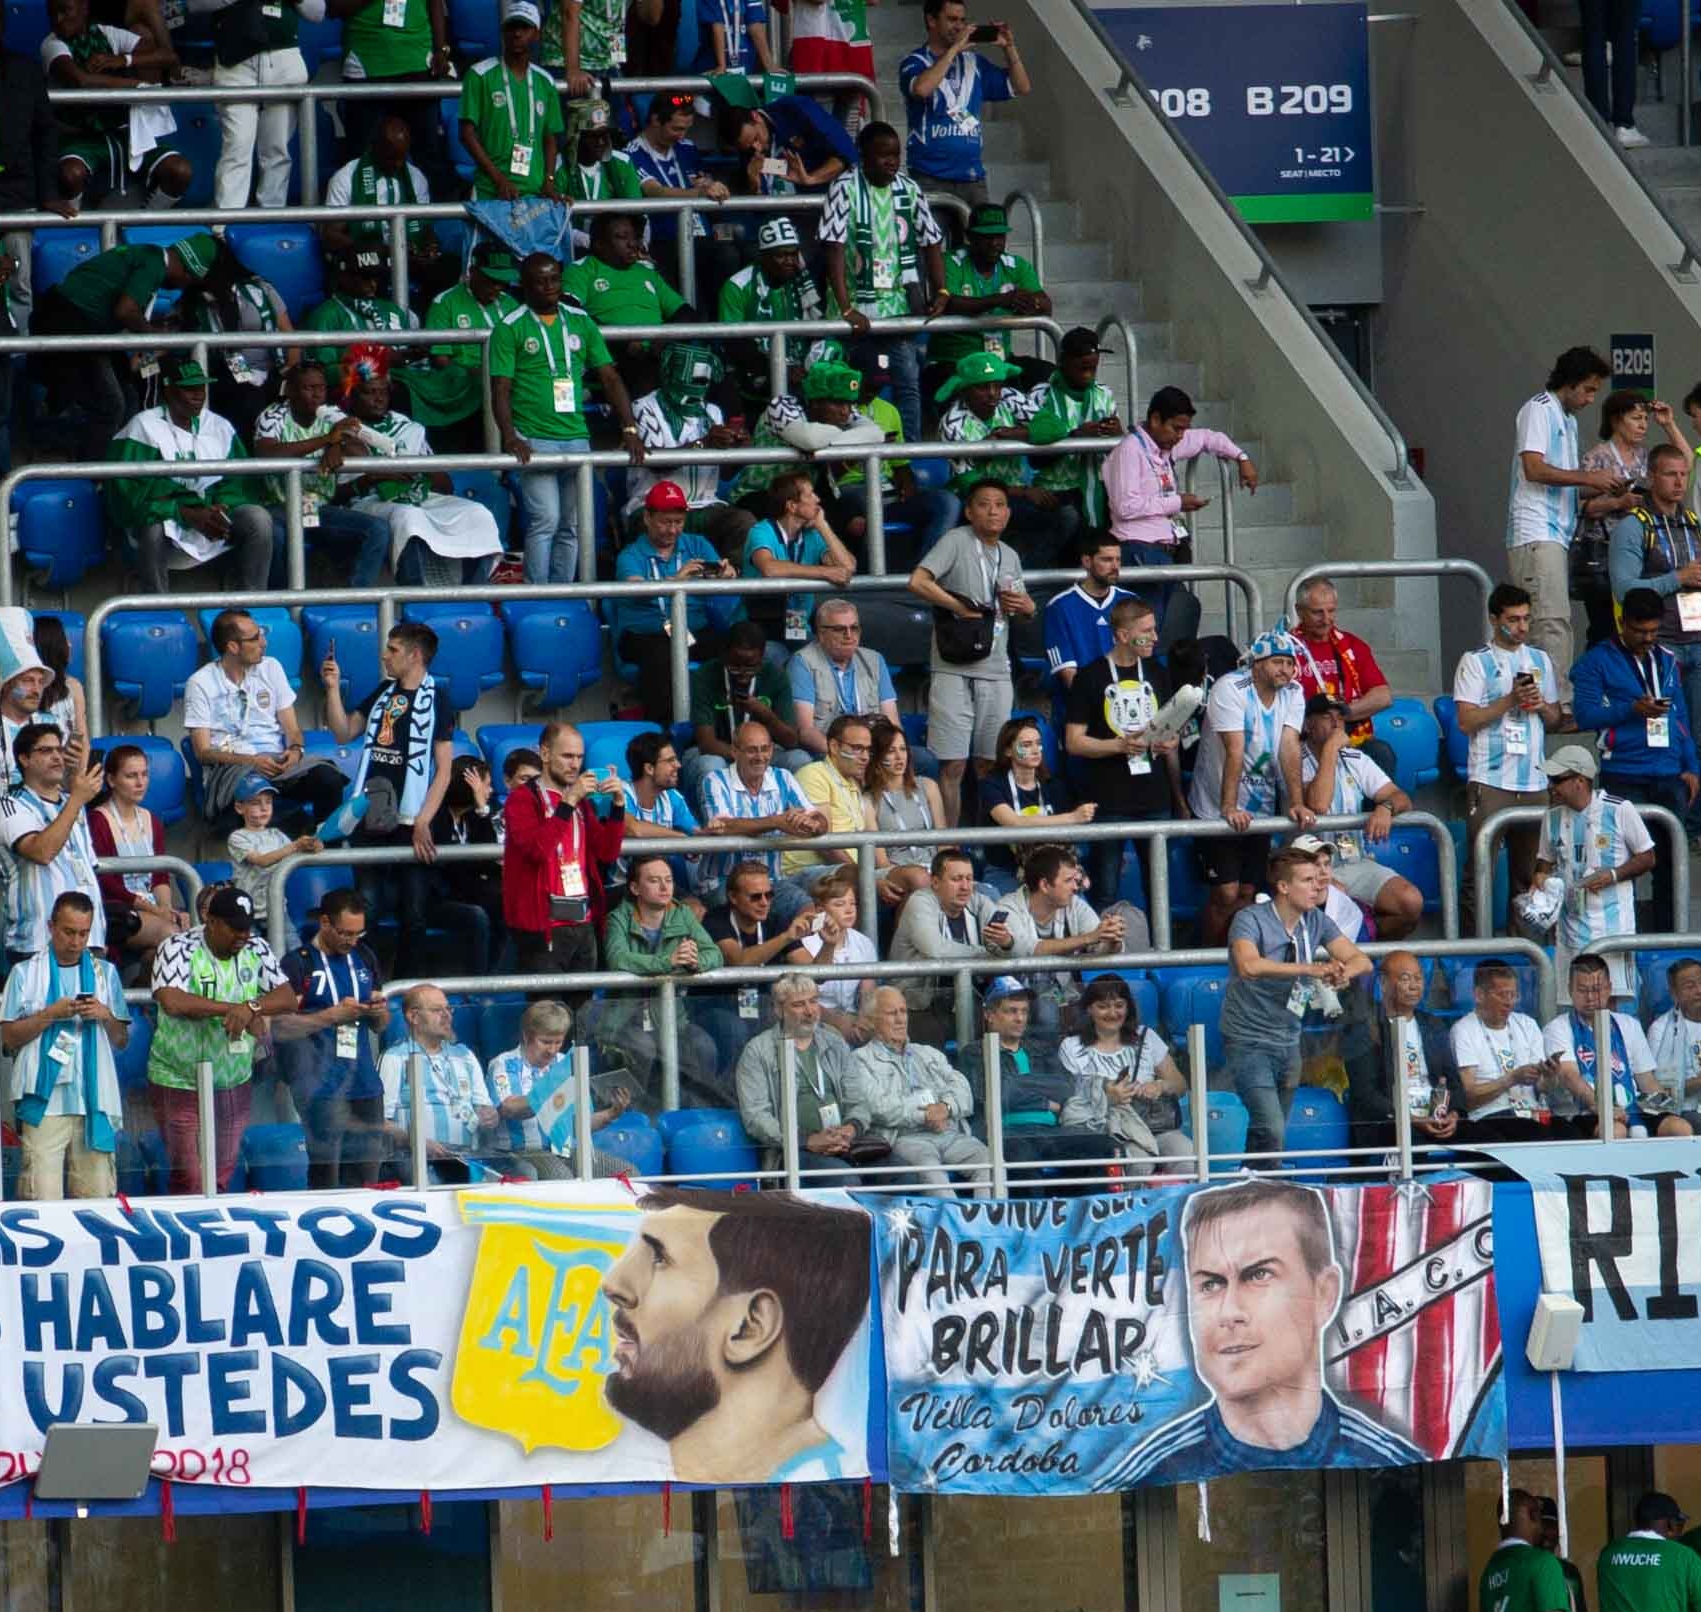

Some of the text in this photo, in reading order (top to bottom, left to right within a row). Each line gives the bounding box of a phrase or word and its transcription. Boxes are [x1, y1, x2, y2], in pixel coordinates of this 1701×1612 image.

[1612, 348, 1653, 375] B209
[312, 969, 326, 996] 7
[76, 1200, 442, 1267] NIETOS
[896, 1213, 1166, 1312] PARA VERTE
[19, 1259, 415, 1353] HABLARE
[486, 1240, 614, 1396] AFA
[931, 1309, 1145, 1378] BRILLAR
[22, 1346, 445, 1442] USTEDES
[899, 1392, 1143, 1435] Villa Dolores
[930, 1440, 1082, 1482] Cordoba
[1610, 1553, 1661, 1567] NWUCHE
